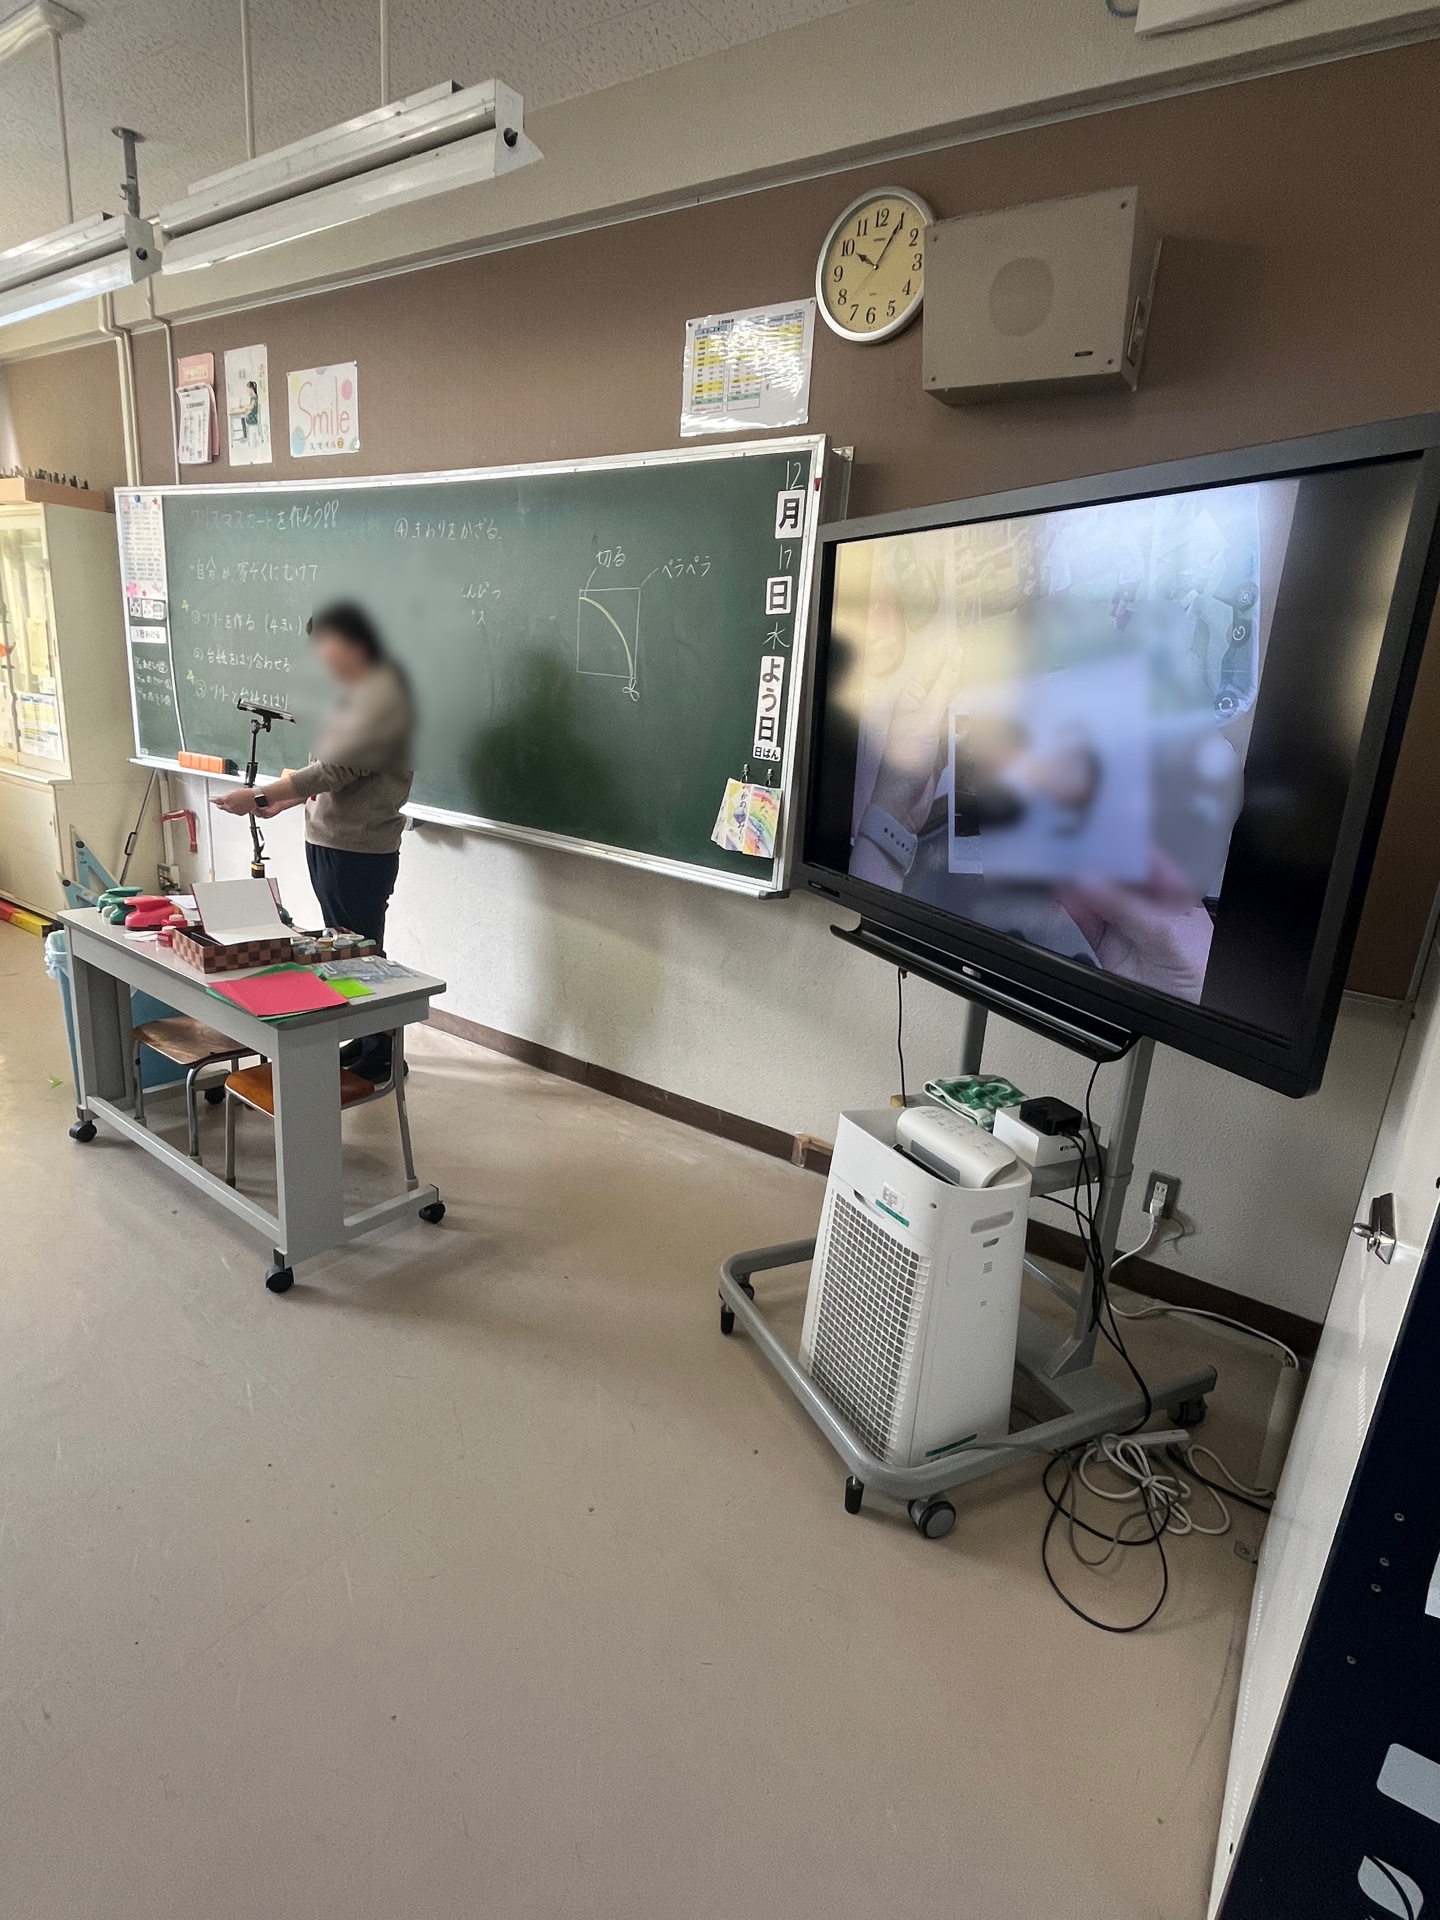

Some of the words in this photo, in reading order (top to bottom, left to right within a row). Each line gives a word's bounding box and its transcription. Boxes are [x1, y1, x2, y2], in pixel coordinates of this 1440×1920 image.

[856, 217, 869, 237] 11
[874, 208, 890, 228] 12
[840, 238, 855, 257] 10
[909, 228, 919, 247] 2
[912, 253, 923, 271] 3
[833, 265, 844, 283] 9
[837, 288, 847, 305] 8
[902, 279, 912, 296] 4
[849, 304, 859, 321] 7
[865, 306, 876, 324] 6
[886, 300, 896, 317] 5
[298, 375, 350, 440] Smile
[785, 460, 804, 491] 12
[779, 498, 800, 530] 月
[596, 546, 626, 568] 切る
[661, 555, 711, 579] ペラペラ
[779, 544, 793, 570] 17
[769, 580, 788, 611] 日
[762, 622, 790, 650] 水
[758, 658, 781, 743] よう日
[754, 746, 779, 761] 日ばん
